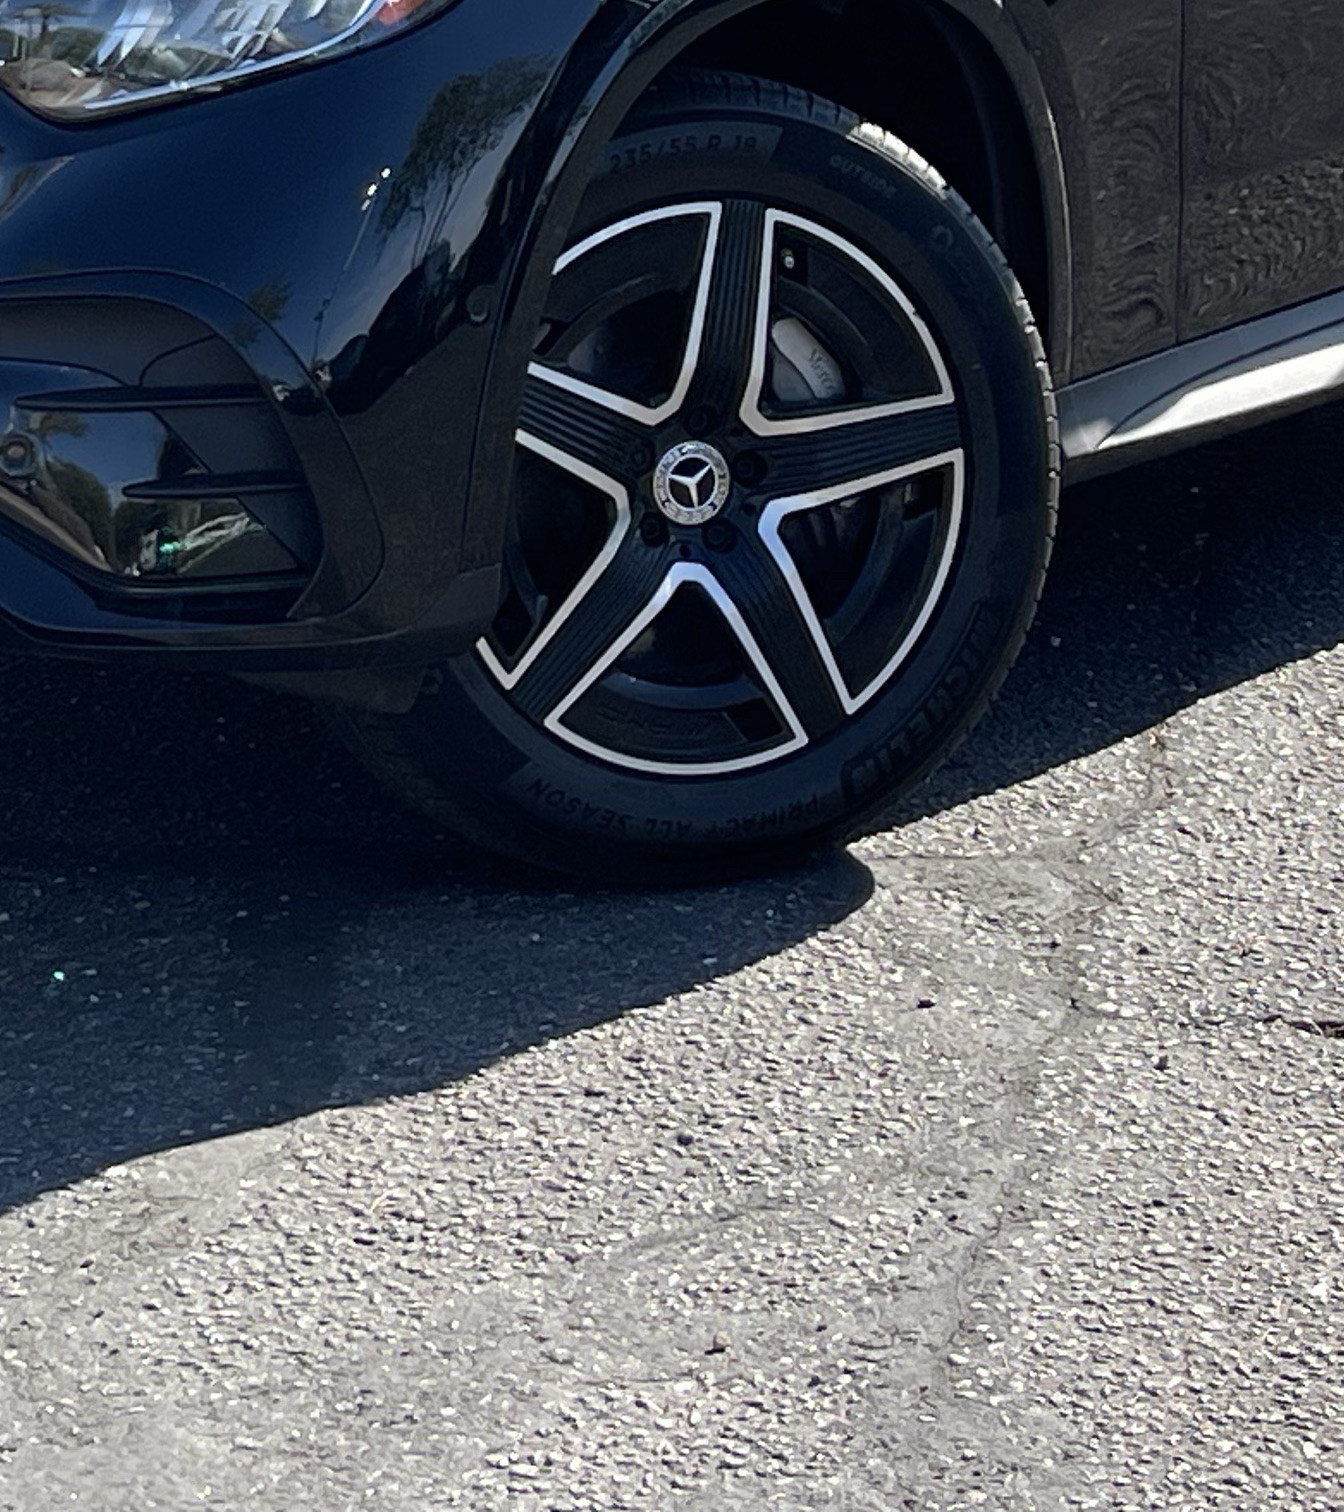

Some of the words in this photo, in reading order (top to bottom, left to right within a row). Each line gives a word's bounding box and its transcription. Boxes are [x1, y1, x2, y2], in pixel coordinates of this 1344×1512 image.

[609, 134, 698, 174] 235/55
[707, 133, 722, 151] R
[528, 779, 635, 830] SEASON
[645, 817, 692, 837] ALL
